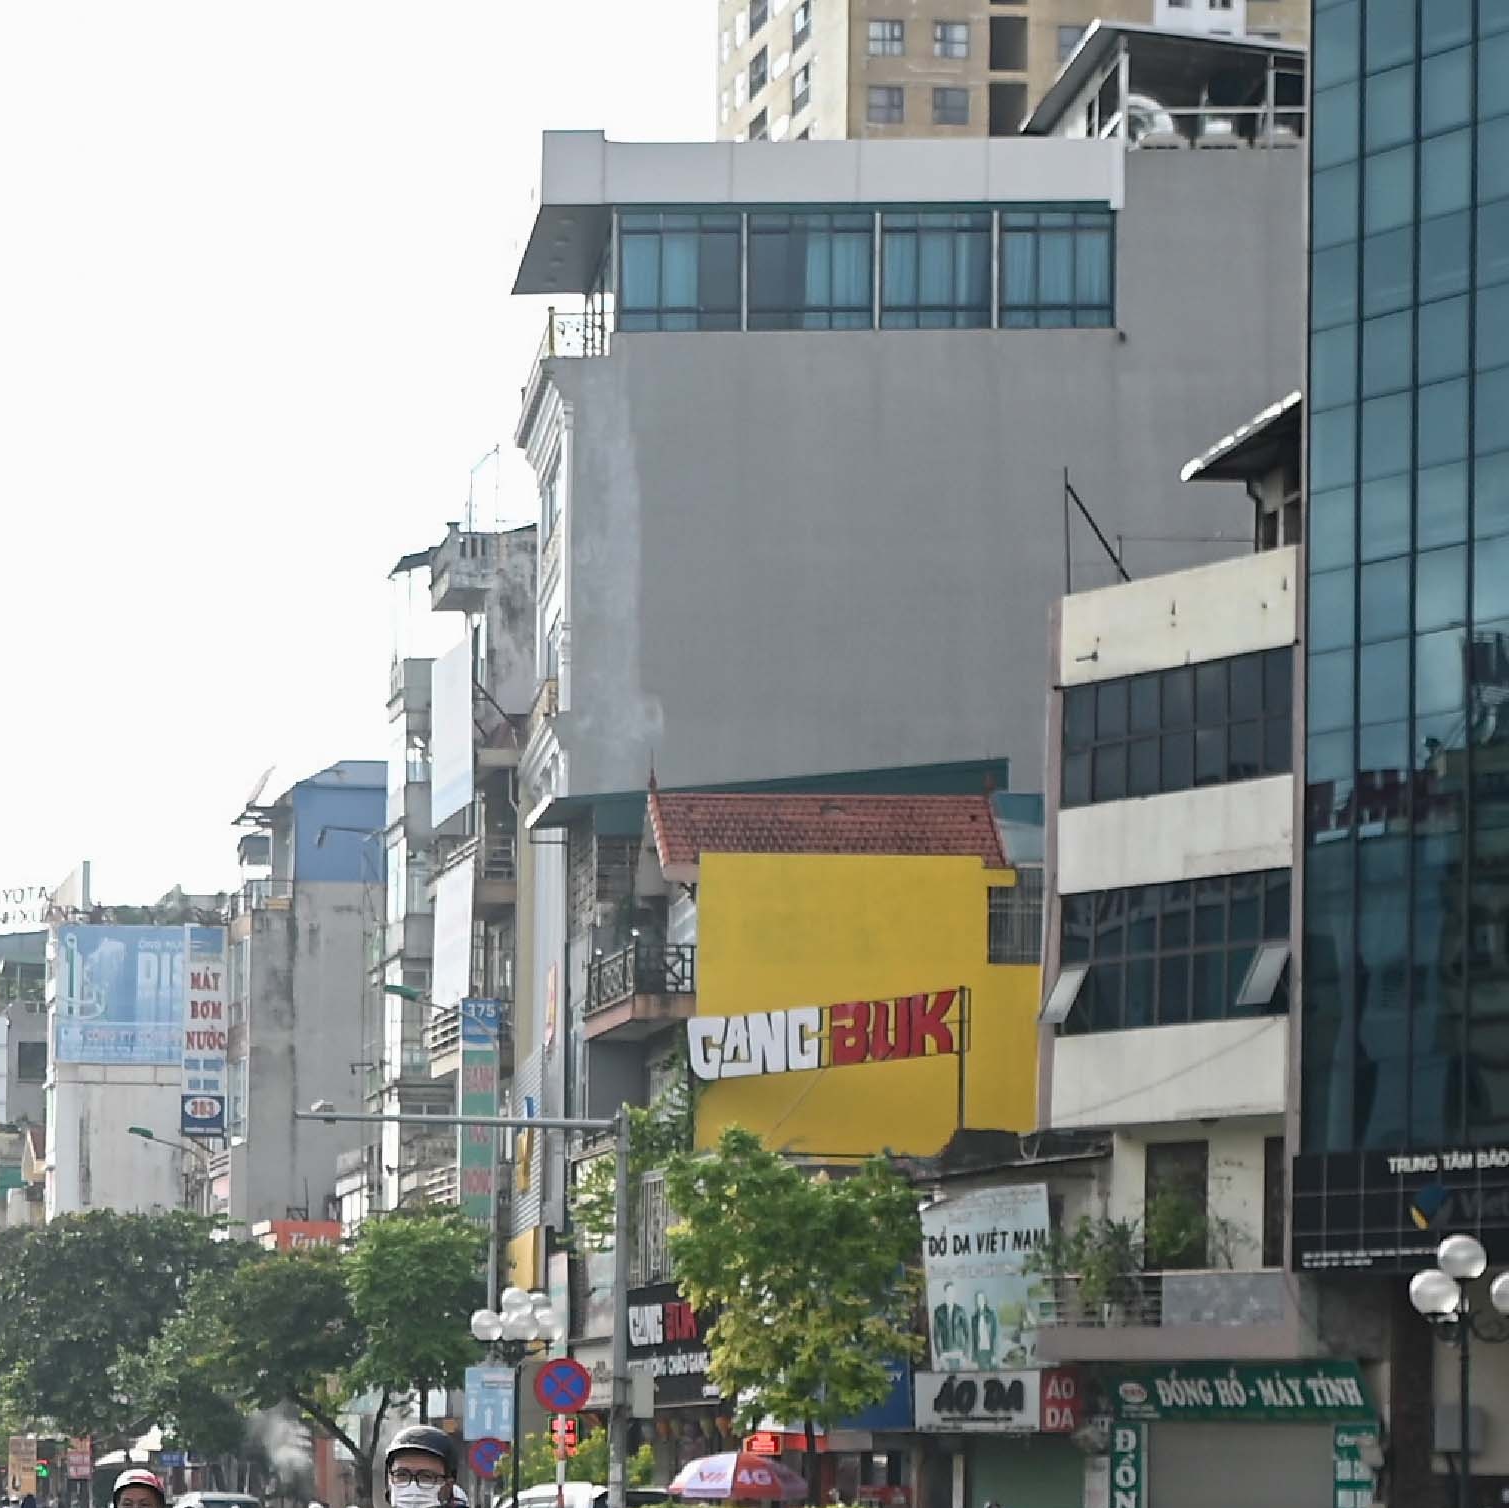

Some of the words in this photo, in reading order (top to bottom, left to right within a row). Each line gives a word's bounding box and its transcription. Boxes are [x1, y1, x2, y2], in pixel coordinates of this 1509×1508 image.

[467, 1003, 496, 1018] 375
[832, 990, 957, 1066] BUK
[1387, 1156, 1438, 1174] TRUNG
[1442, 1150, 1473, 1170] TÂM
[953, 1234, 972, 1256] DA
[1257, 1370, 1306, 1406] MÁY
[1306, 1368, 1364, 1406] TÍNH
[1046, 1407, 1074, 1428] DA
